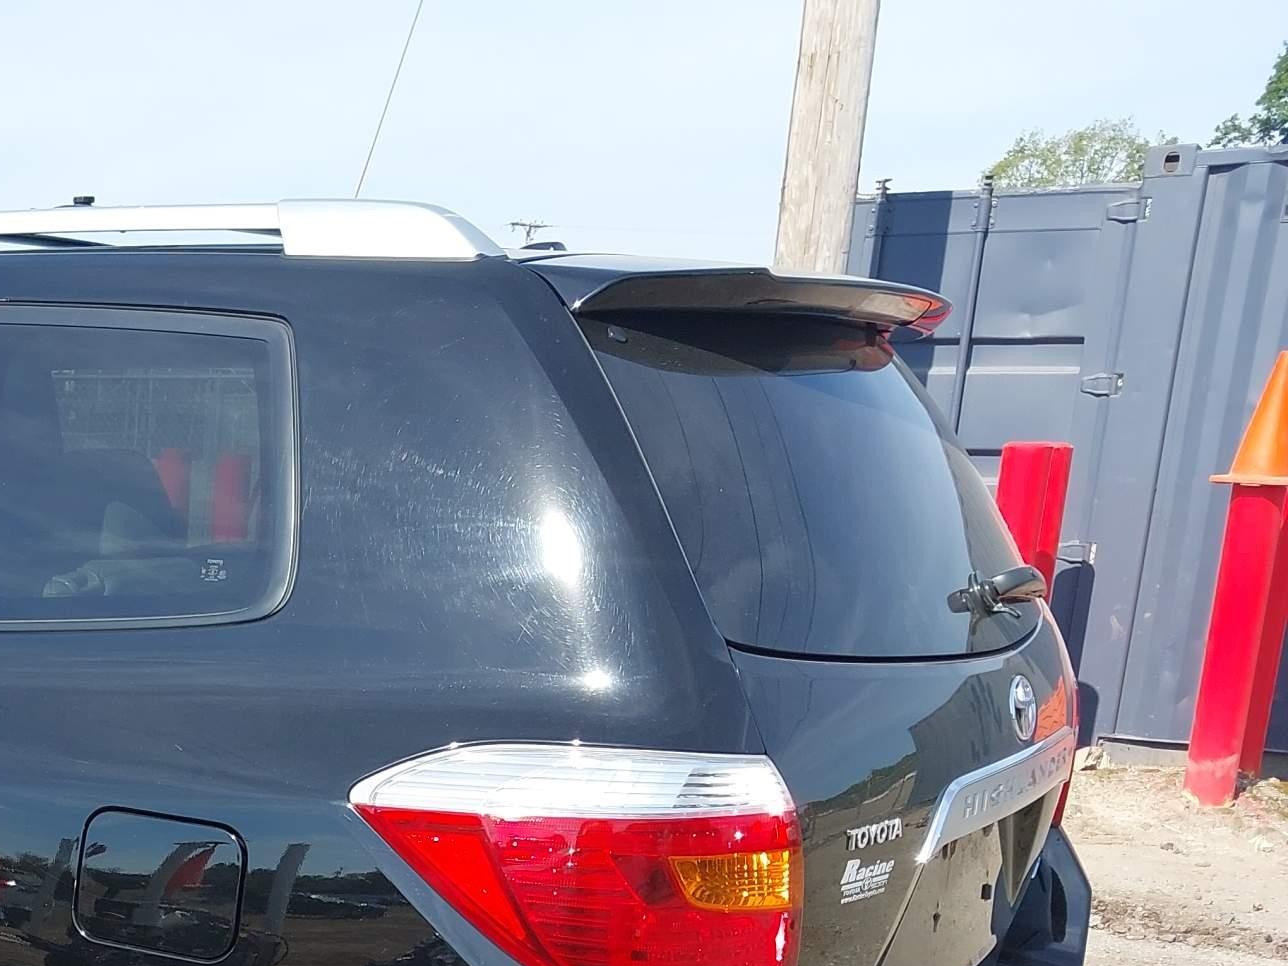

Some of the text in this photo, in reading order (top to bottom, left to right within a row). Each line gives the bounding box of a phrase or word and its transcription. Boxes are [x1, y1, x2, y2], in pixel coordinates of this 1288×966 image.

[962, 745, 1073, 820] HIGHLANDER
[845, 817, 903, 851] TOYOTA
[840, 859, 895, 885] Racine
